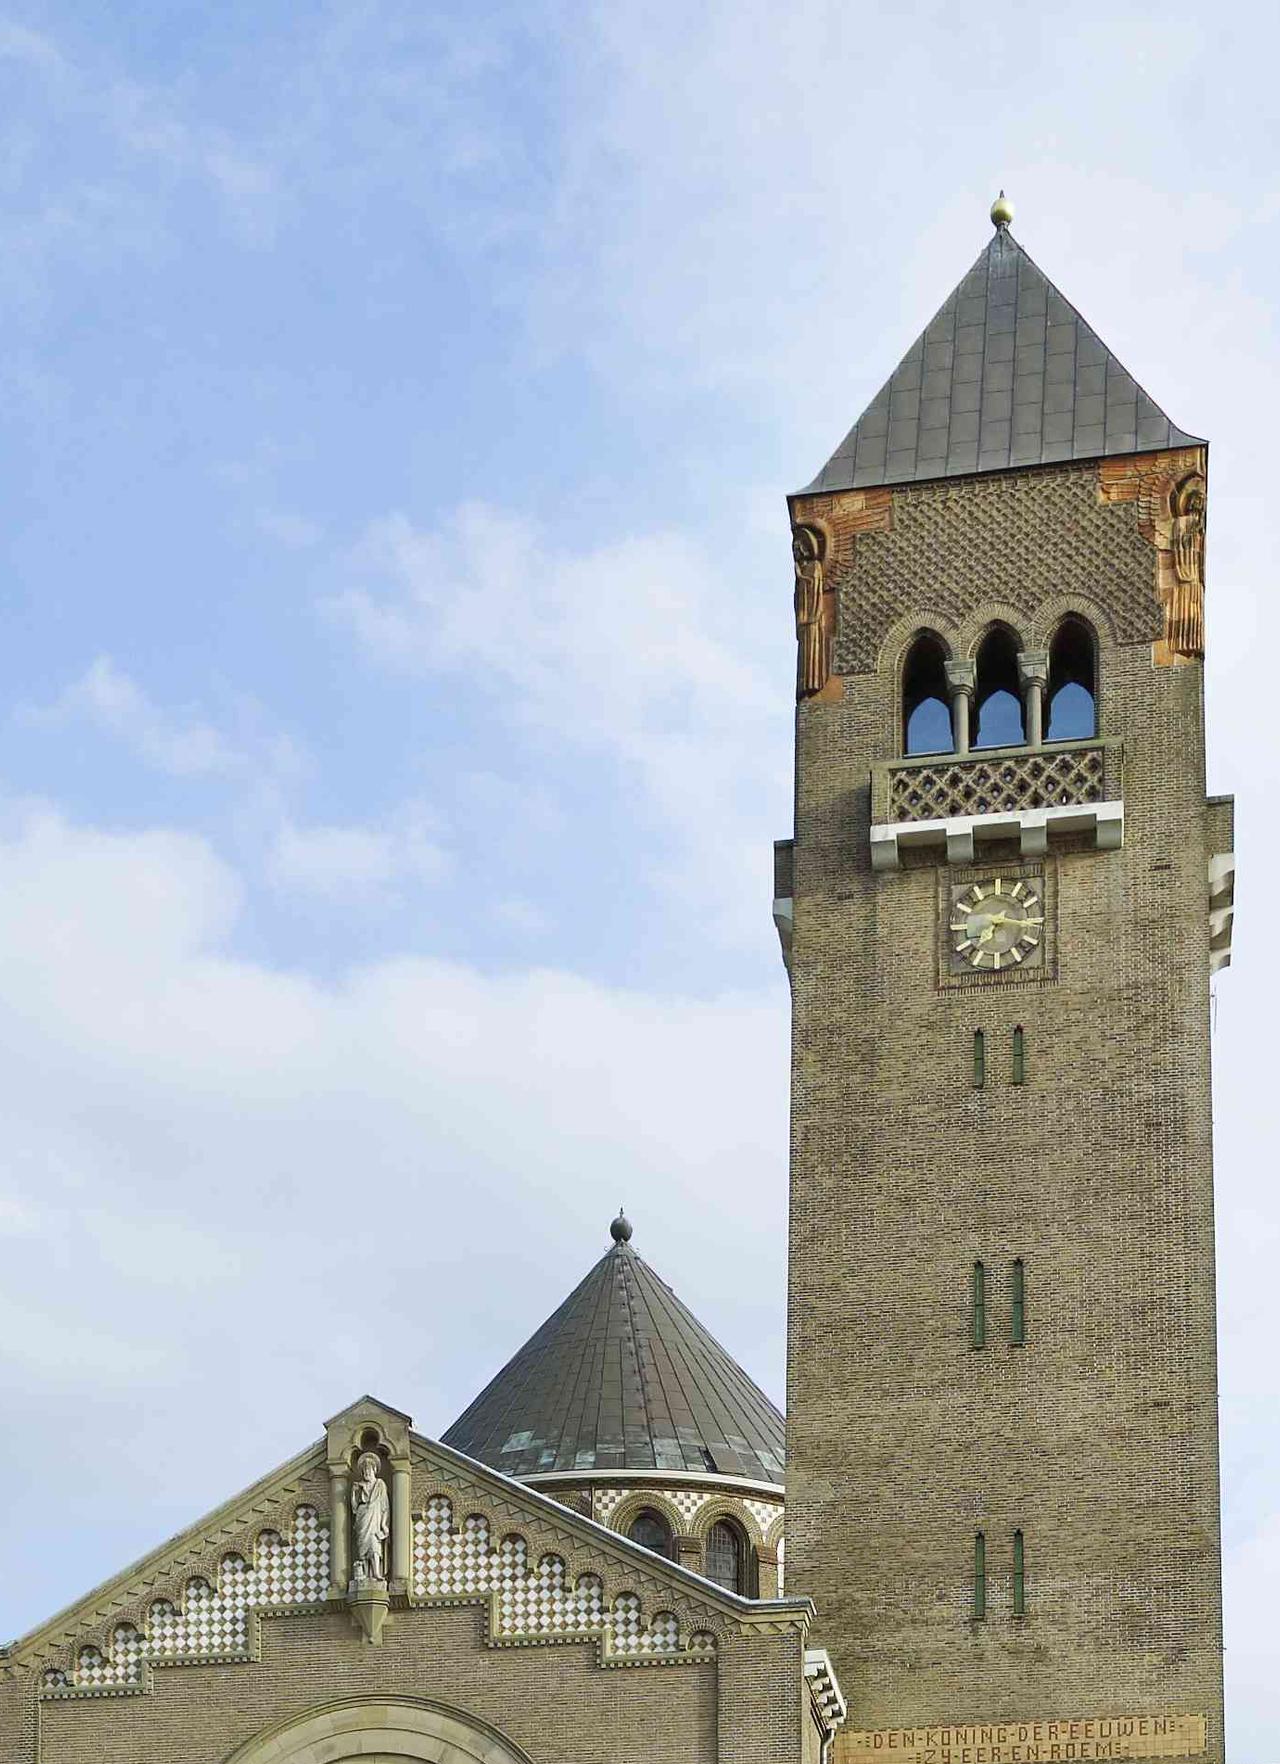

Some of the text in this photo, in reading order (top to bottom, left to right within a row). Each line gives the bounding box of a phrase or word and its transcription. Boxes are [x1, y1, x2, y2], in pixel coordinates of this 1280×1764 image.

[873, 1719, 1167, 1749] DEN KONING DER EEUWEN
[962, 1746, 1001, 1764] EER
[1012, 1744, 1039, 1761] EN
[1051, 1741, 1112, 1760] ROEM
